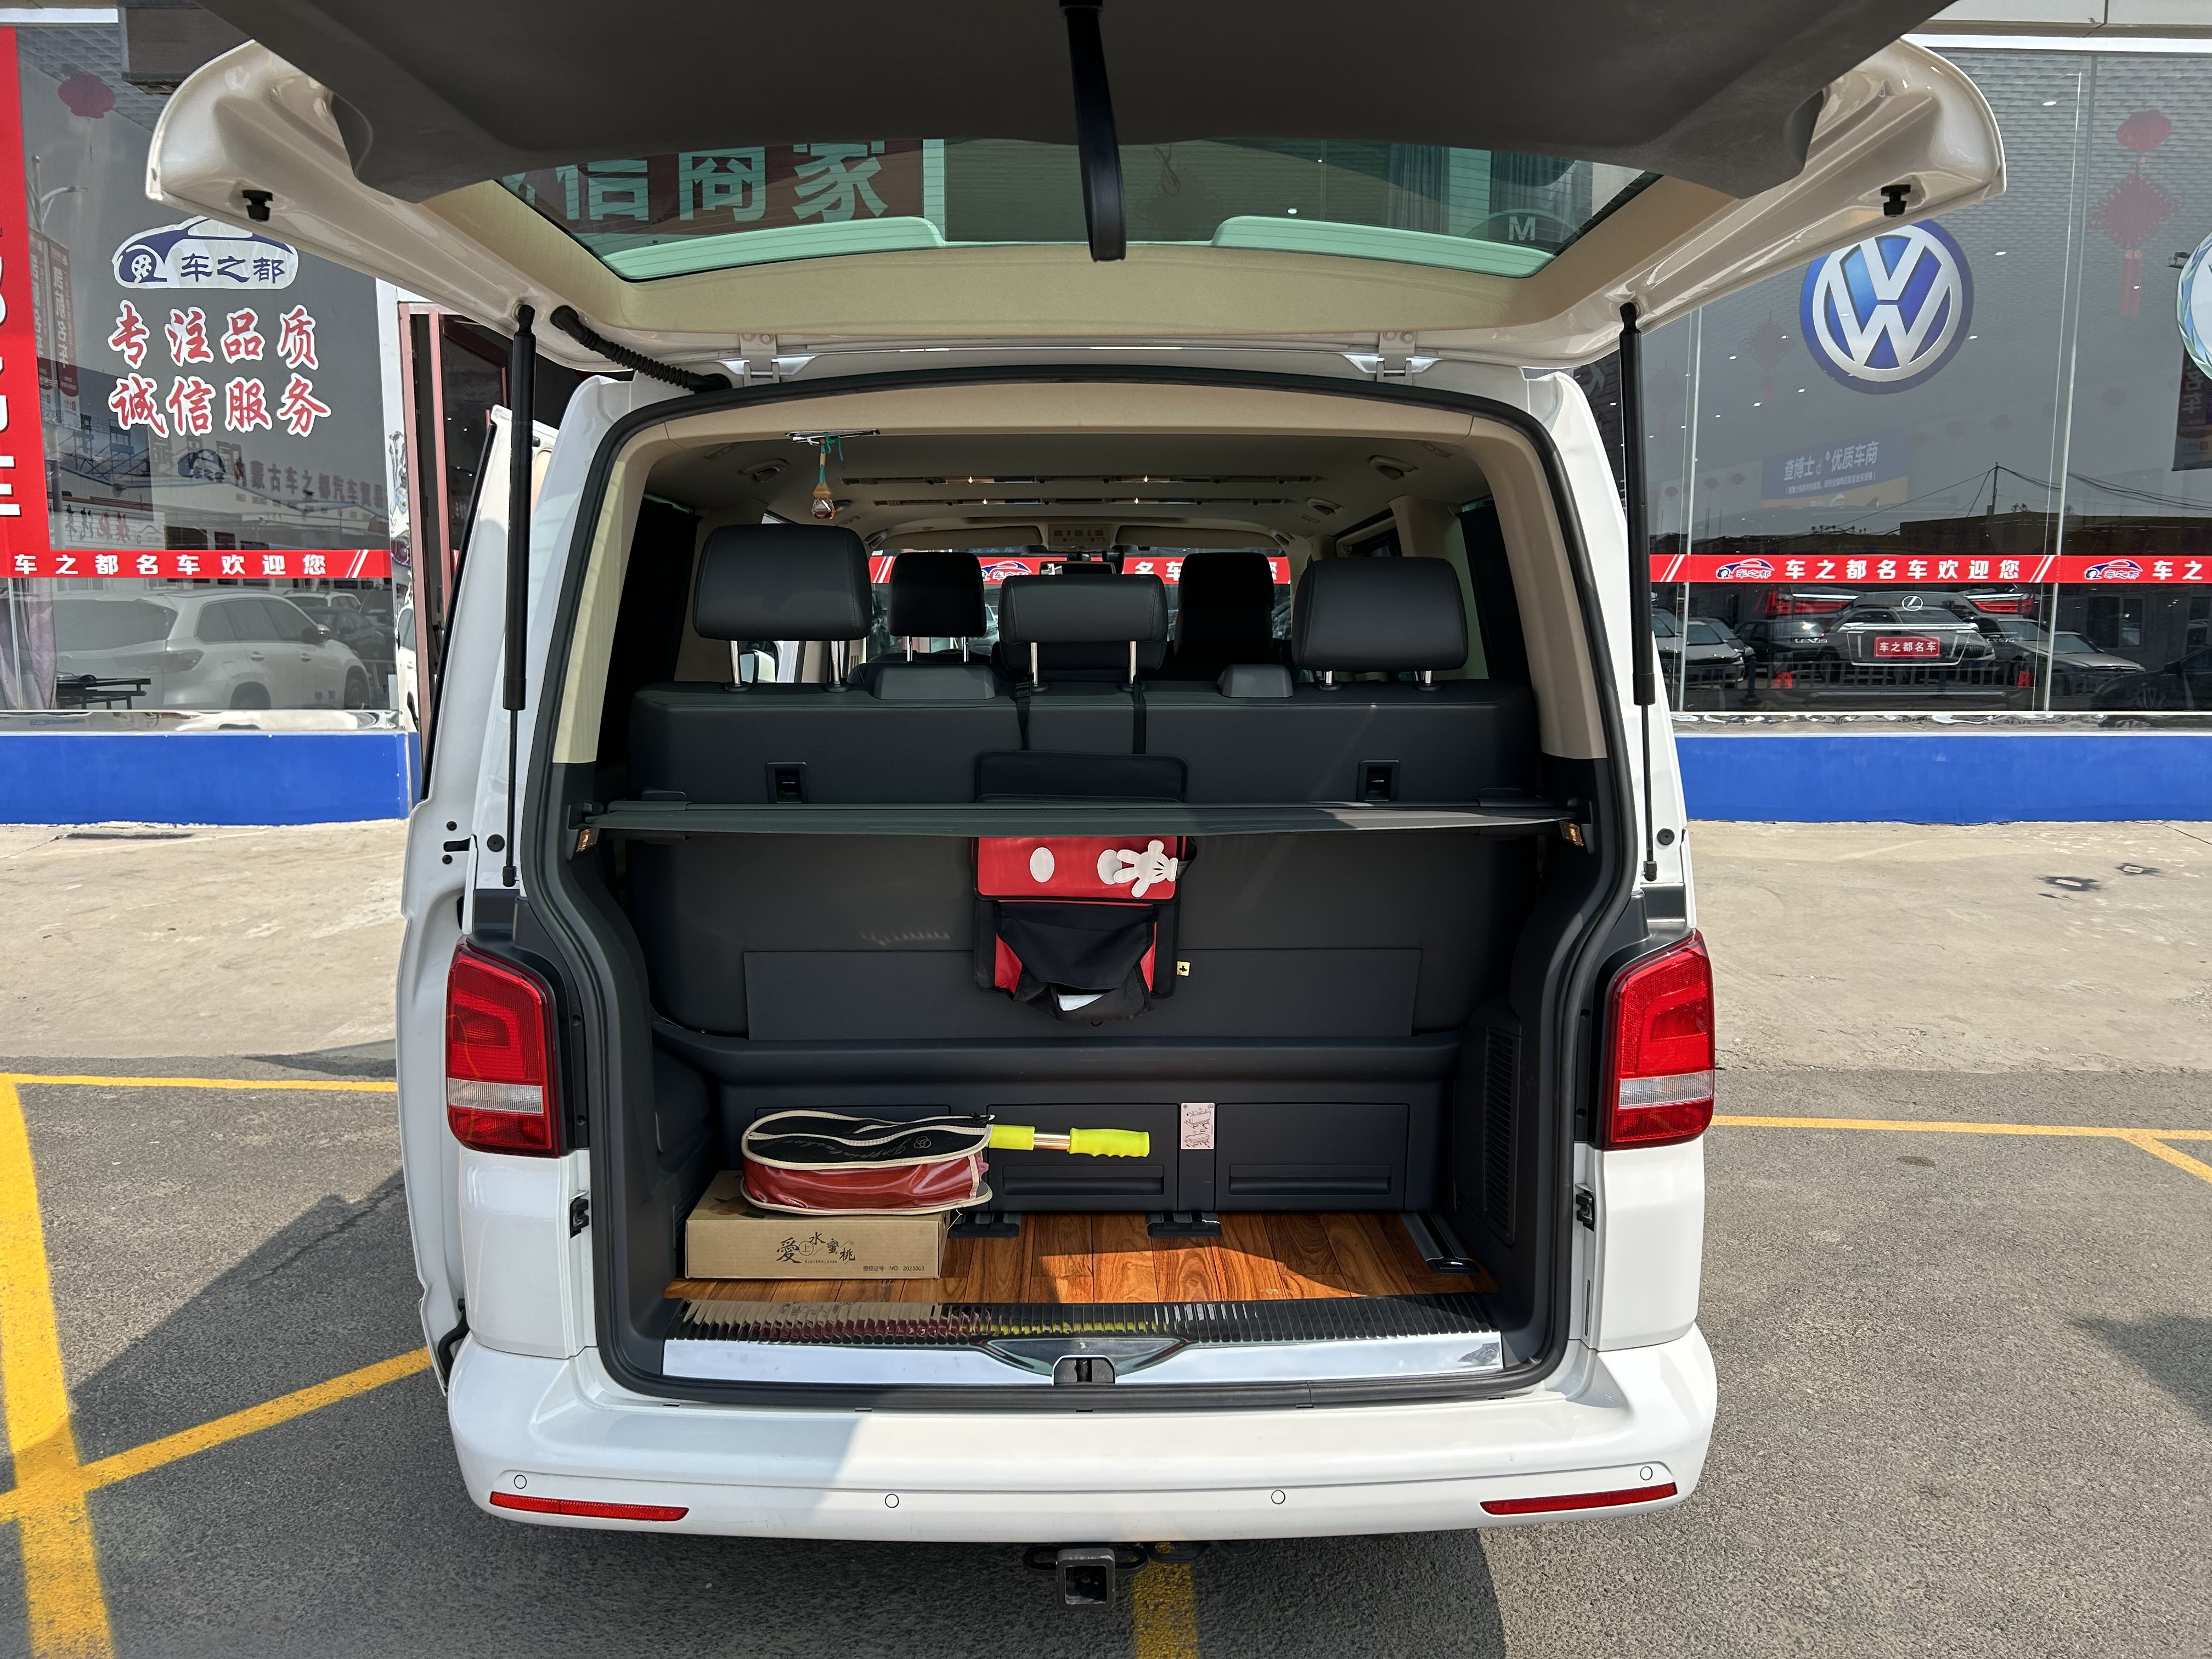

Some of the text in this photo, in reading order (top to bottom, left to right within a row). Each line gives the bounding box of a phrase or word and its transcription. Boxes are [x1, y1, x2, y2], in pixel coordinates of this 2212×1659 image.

[180, 253, 285, 284] 车之都
[109, 300, 319, 370] 专注品质
[109, 373, 331, 438] 诚信服务
[1784, 441, 1879, 481] 查博士 优质车商
[14, 554, 326, 575] 车之都名车欢迎您
[1736, 559, 2020, 580] 车之都 车之都名车欢迎您
[2104, 560, 2203, 580] 车之都 车之
[1878, 641, 1937, 653] 车之都名车
